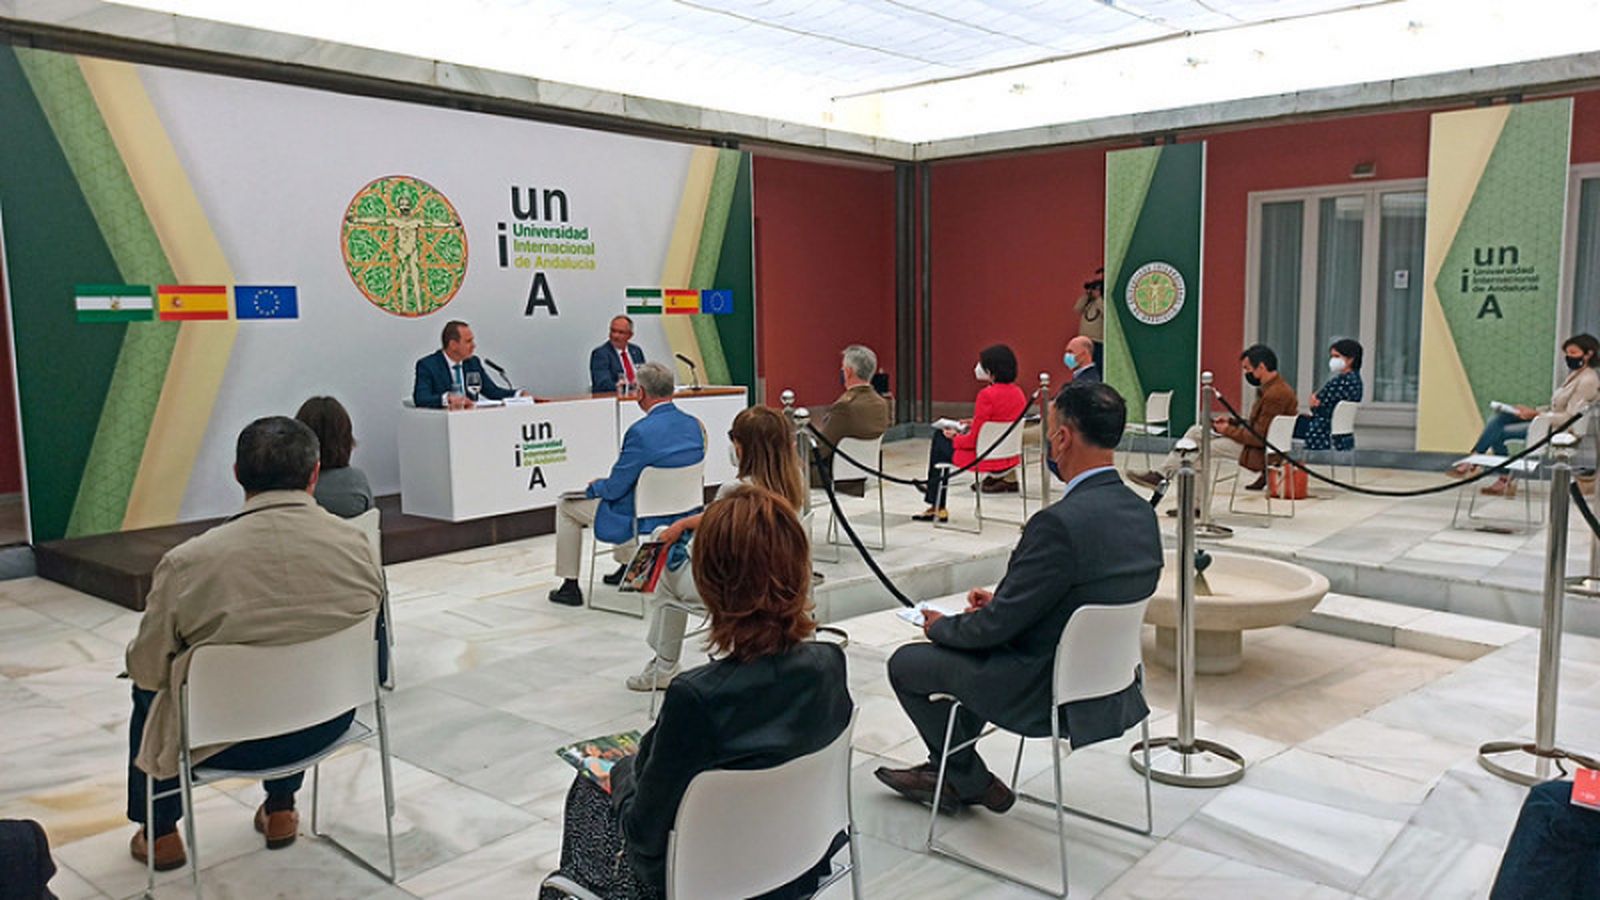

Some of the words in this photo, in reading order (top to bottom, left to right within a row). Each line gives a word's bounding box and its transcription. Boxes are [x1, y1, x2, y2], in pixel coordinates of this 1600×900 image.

[511, 186, 568, 222] un
[513, 223, 588, 240] Universidad
[498, 222, 508, 267] i
[513, 240, 595, 255] Internacional
[514, 256, 531, 268] de
[1474, 245, 1518, 266] un
[1473, 266, 1534, 275] Universidad
[525, 272, 559, 316] A
[1477, 294, 1503, 319] A
[522, 421, 552, 441] un
[529, 466, 546, 490] A
